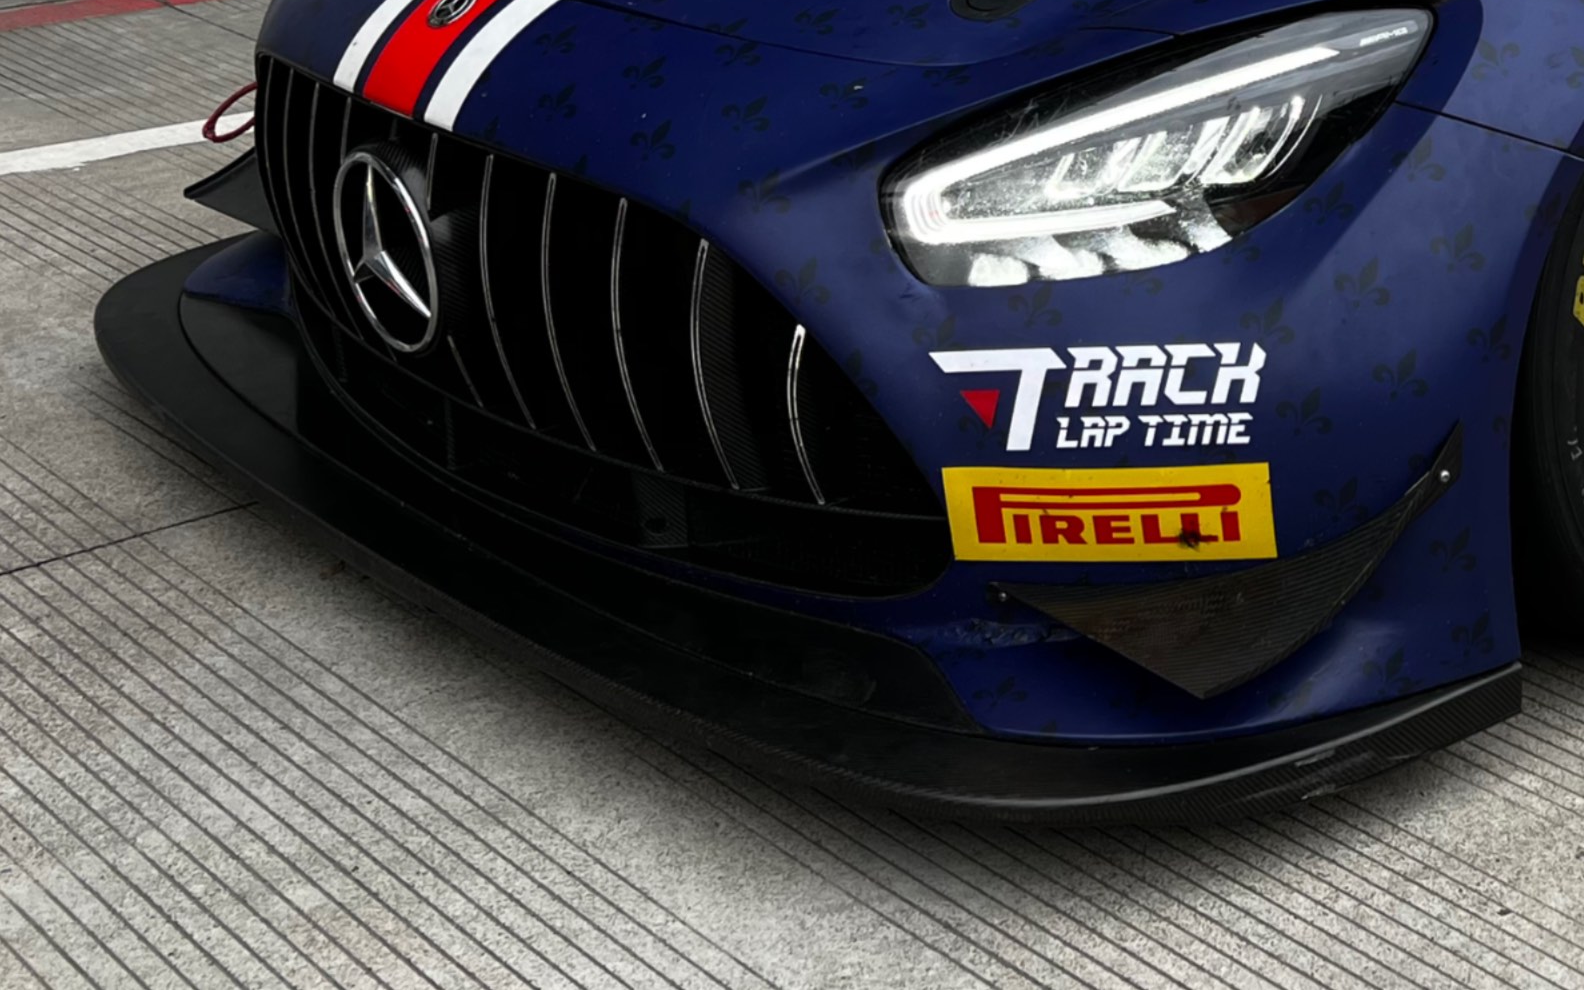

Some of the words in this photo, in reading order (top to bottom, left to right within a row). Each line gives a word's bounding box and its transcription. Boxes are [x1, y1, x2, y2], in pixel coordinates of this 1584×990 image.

[928, 342, 1267, 451] TRACK
[1055, 415, 1131, 449] LAP
[1137, 412, 1254, 447] TIME
[972, 483, 1242, 545] PIRELLI
